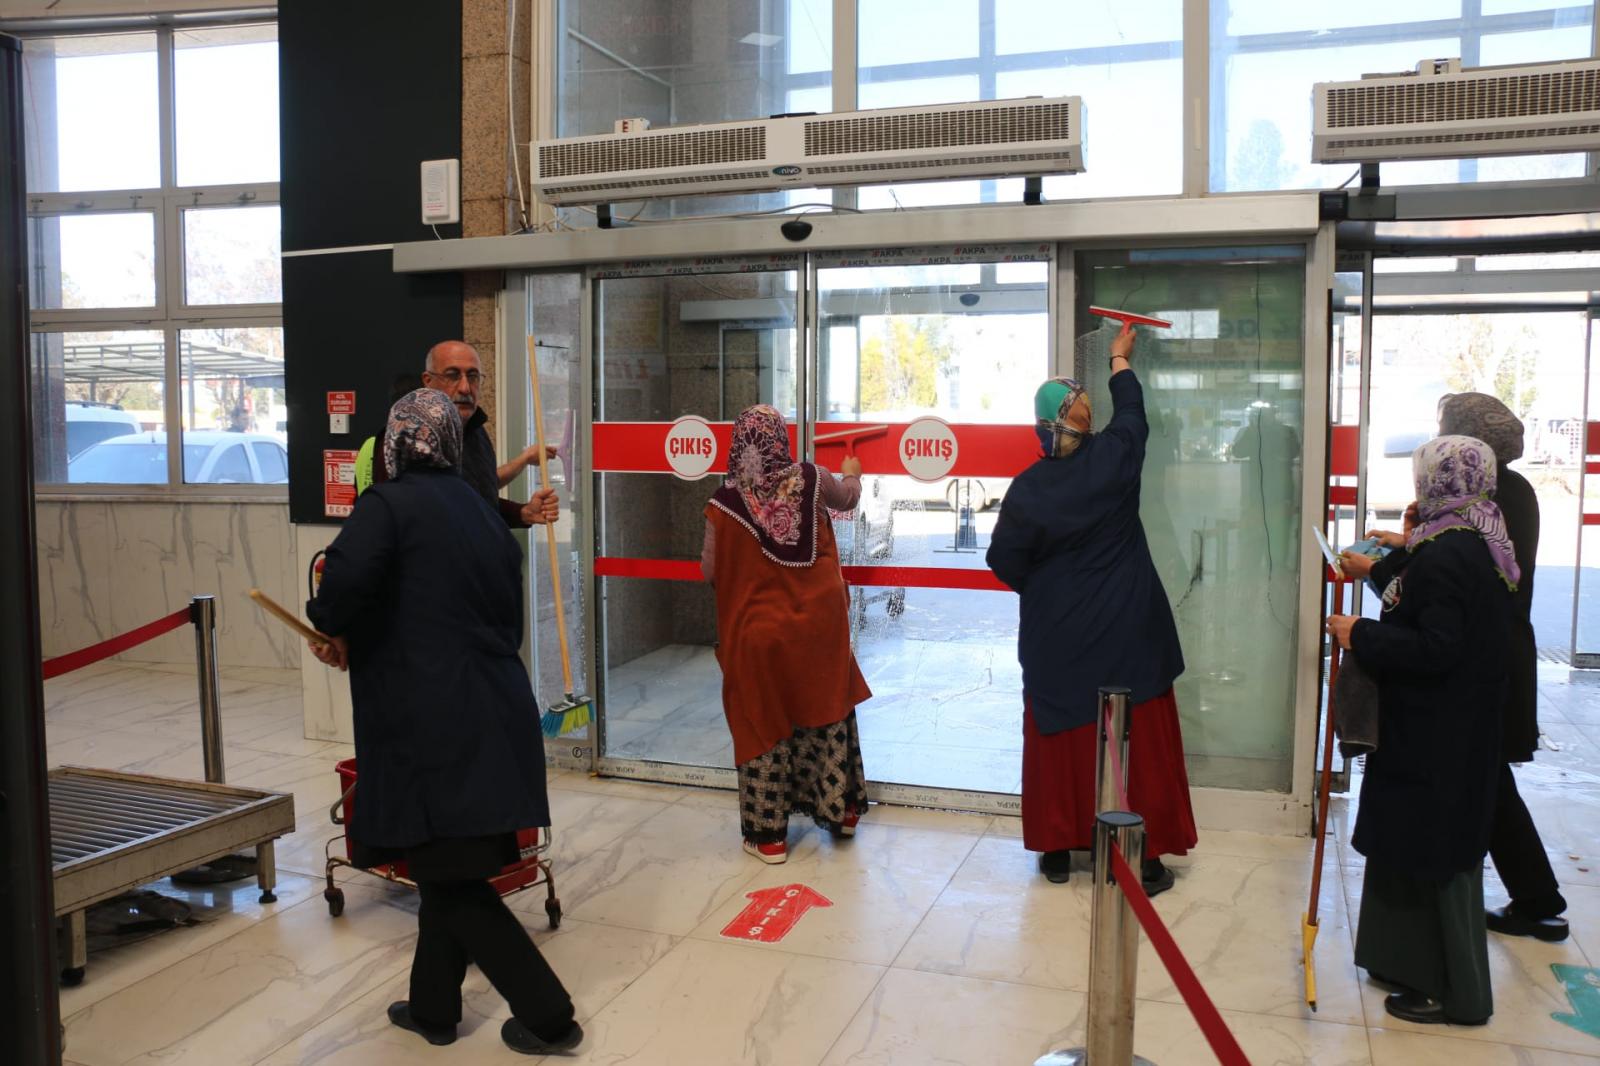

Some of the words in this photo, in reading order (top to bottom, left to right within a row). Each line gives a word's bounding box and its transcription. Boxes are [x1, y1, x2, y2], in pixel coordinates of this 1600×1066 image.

[880, 249, 904, 257] AKPA
[961, 247, 986, 255] AKPA
[927, 256, 952, 264] AKPA
[1012, 254, 1036, 262] AKPA
[670, 437, 712, 459] ÇIKIŞ
[905, 438, 953, 461] ÇIKIŞ
[615, 766, 636, 774] AKPA
[684, 773, 705, 782] AKPA
[996, 801, 1021, 809] AKPA
